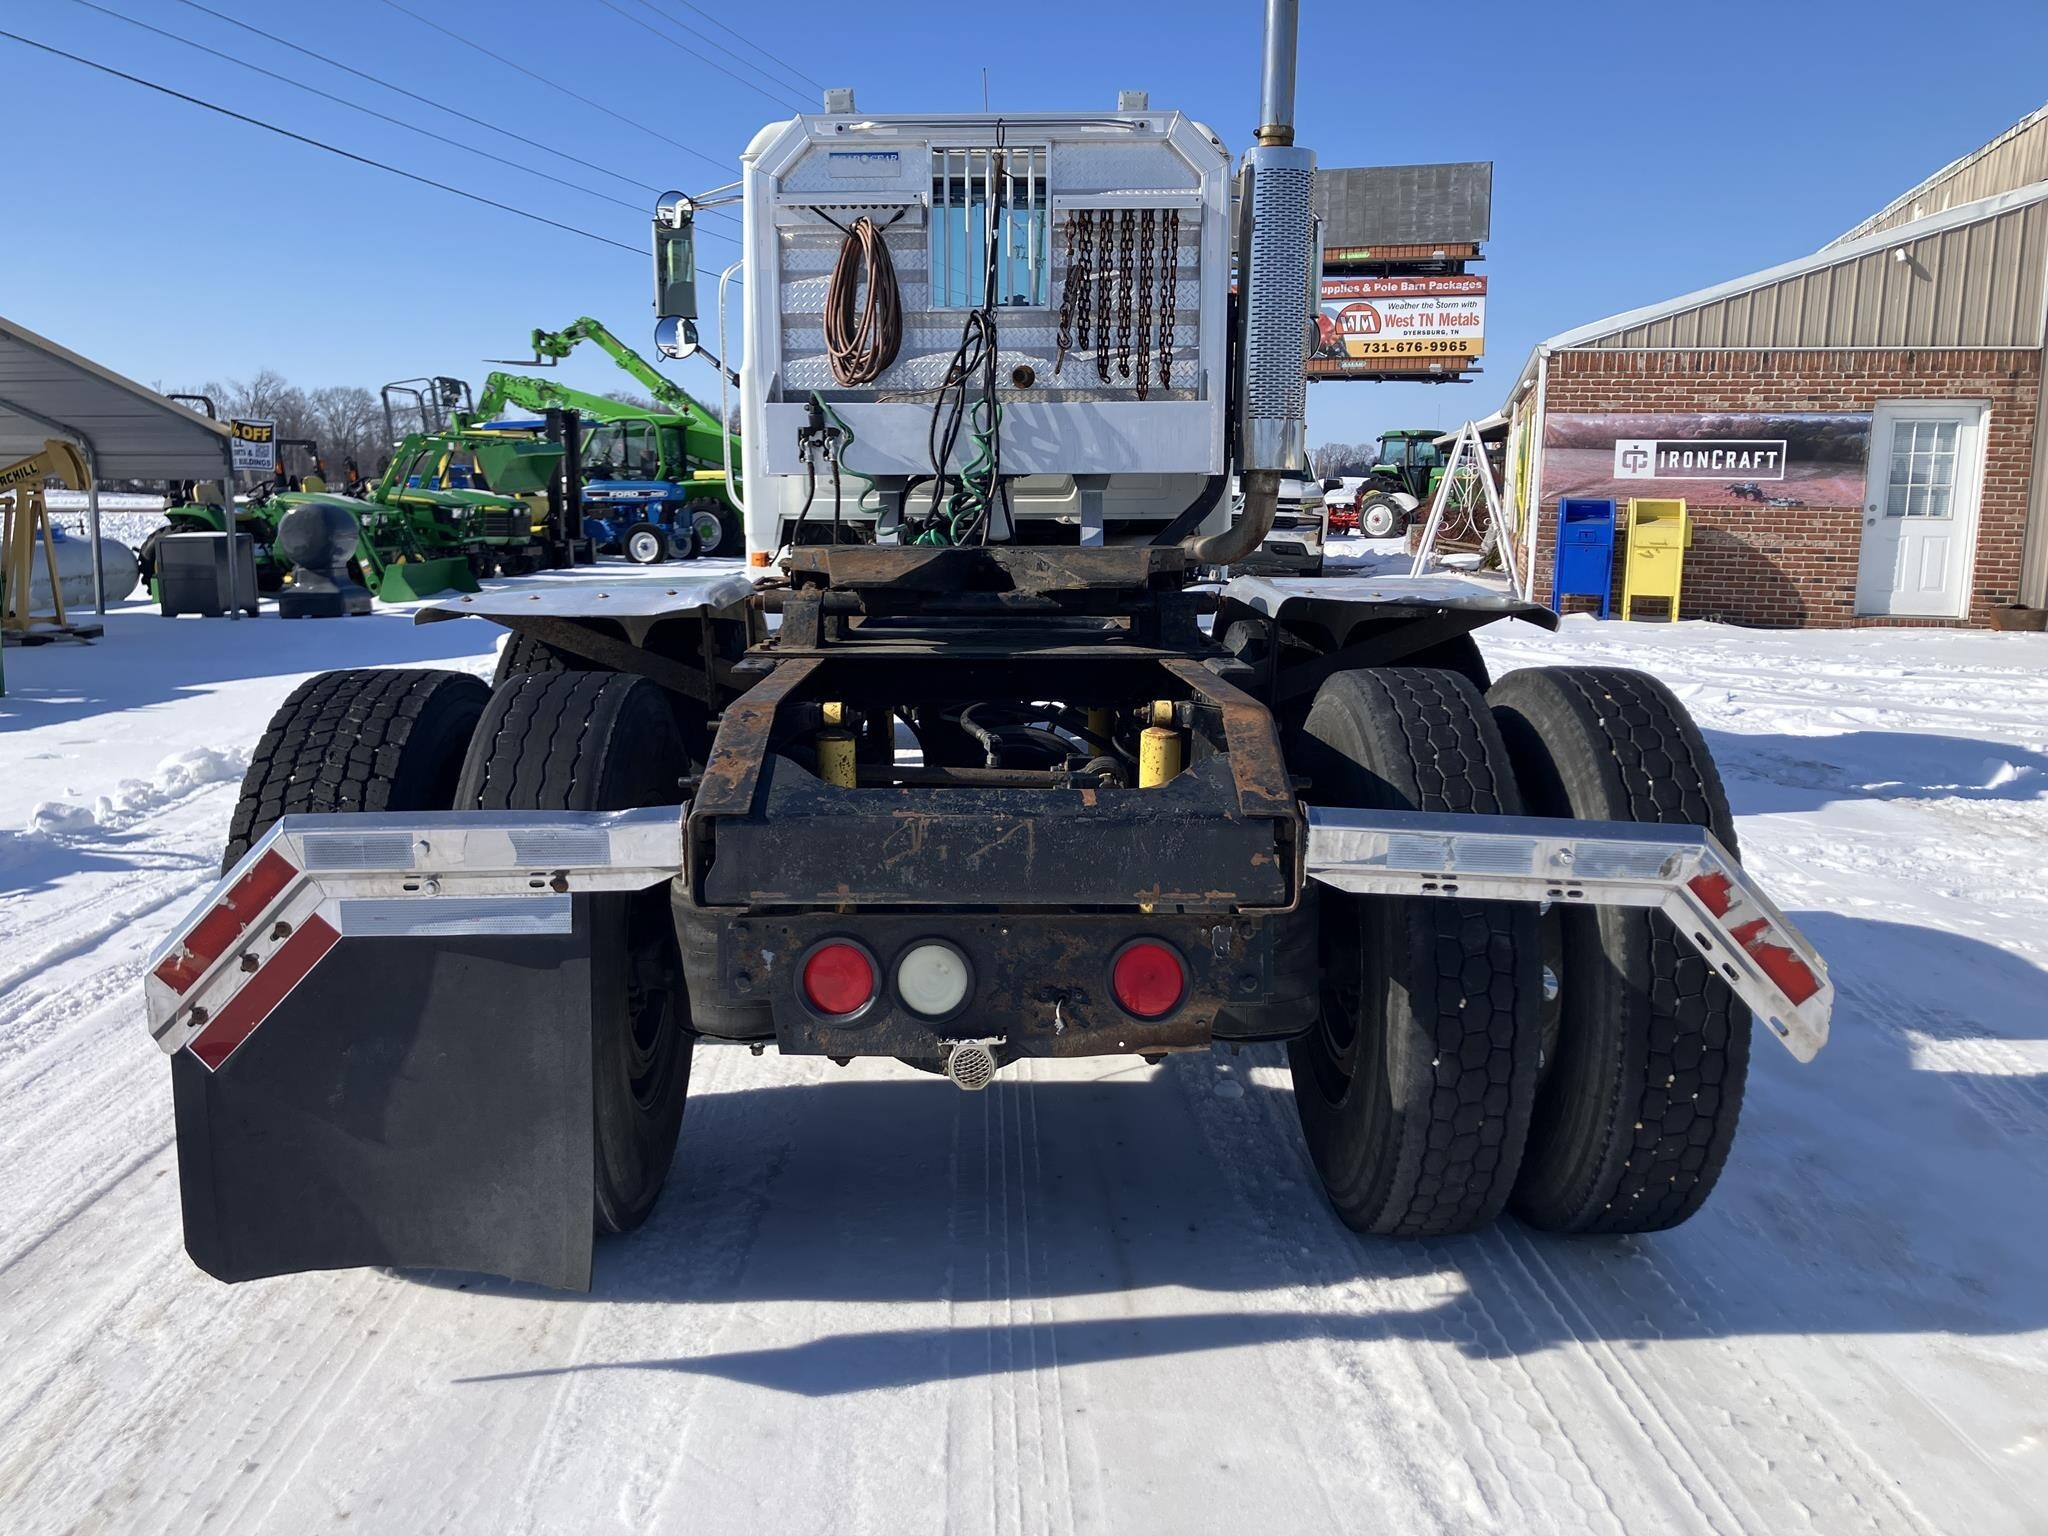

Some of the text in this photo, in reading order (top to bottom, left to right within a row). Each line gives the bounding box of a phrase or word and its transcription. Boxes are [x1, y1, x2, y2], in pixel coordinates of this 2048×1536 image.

[1321, 280, 1482, 295] upplies & Pole Barn Packages
[1388, 300, 1478, 310] Weather the Storm with
[1384, 312, 1480, 328] West TN Metals
[1363, 341, 1468, 353] 731-676-9965
[242, 425, 271, 441] OFF
[1660, 449, 1778, 470] IRONCRAFT
[0, 463, 37, 487] RCHILL
